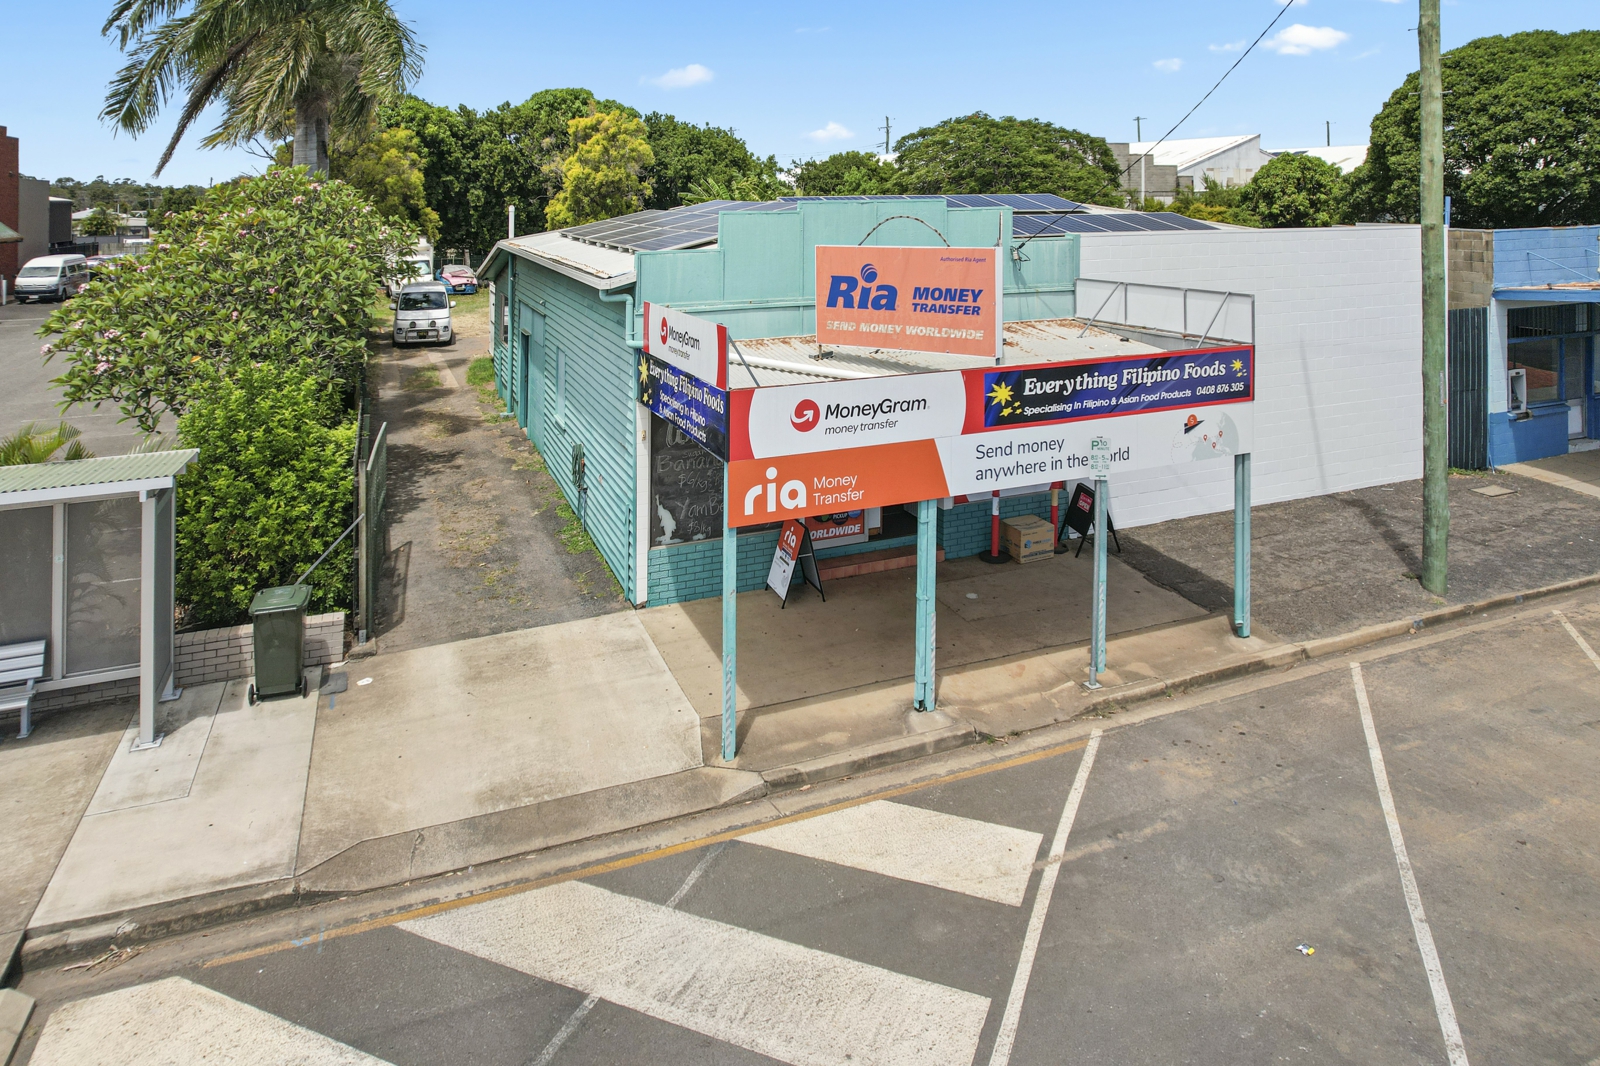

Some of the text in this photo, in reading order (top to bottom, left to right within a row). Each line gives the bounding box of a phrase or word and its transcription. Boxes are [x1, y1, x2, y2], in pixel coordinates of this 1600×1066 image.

[826, 263, 898, 311] Ria
[913, 287, 983, 302] MONEY
[912, 303, 981, 315] TRANSFER
[669, 325, 700, 350] MoneyGram
[826, 320, 984, 340] SEND MONEY WORLDWIDE
[650, 360, 724, 414] Everything Filipino Foods
[1023, 360, 1227, 395] Everything Filipino Foods
[825, 398, 927, 420] MoneyGram
[1023, 382, 1244, 416] Specialising In Filipino & Asian Food Products 0408 876 305
[675, 413, 686, 429] Food
[686, 420, 706, 442] Products
[690, 408, 705, 426] Filipino
[825, 418, 898, 435] money transfer
[975, 438, 1065, 460] Send money
[975, 460, 1047, 482] anywhere
[1050, 456, 1063, 471] in
[1067, 452, 1089, 468] the
[744, 466, 807, 516] ria
[813, 475, 858, 489] Money
[813, 488, 864, 505] Transfer
[784, 526, 796, 548] ria
[811, 524, 861, 540] ORLDWIDE
